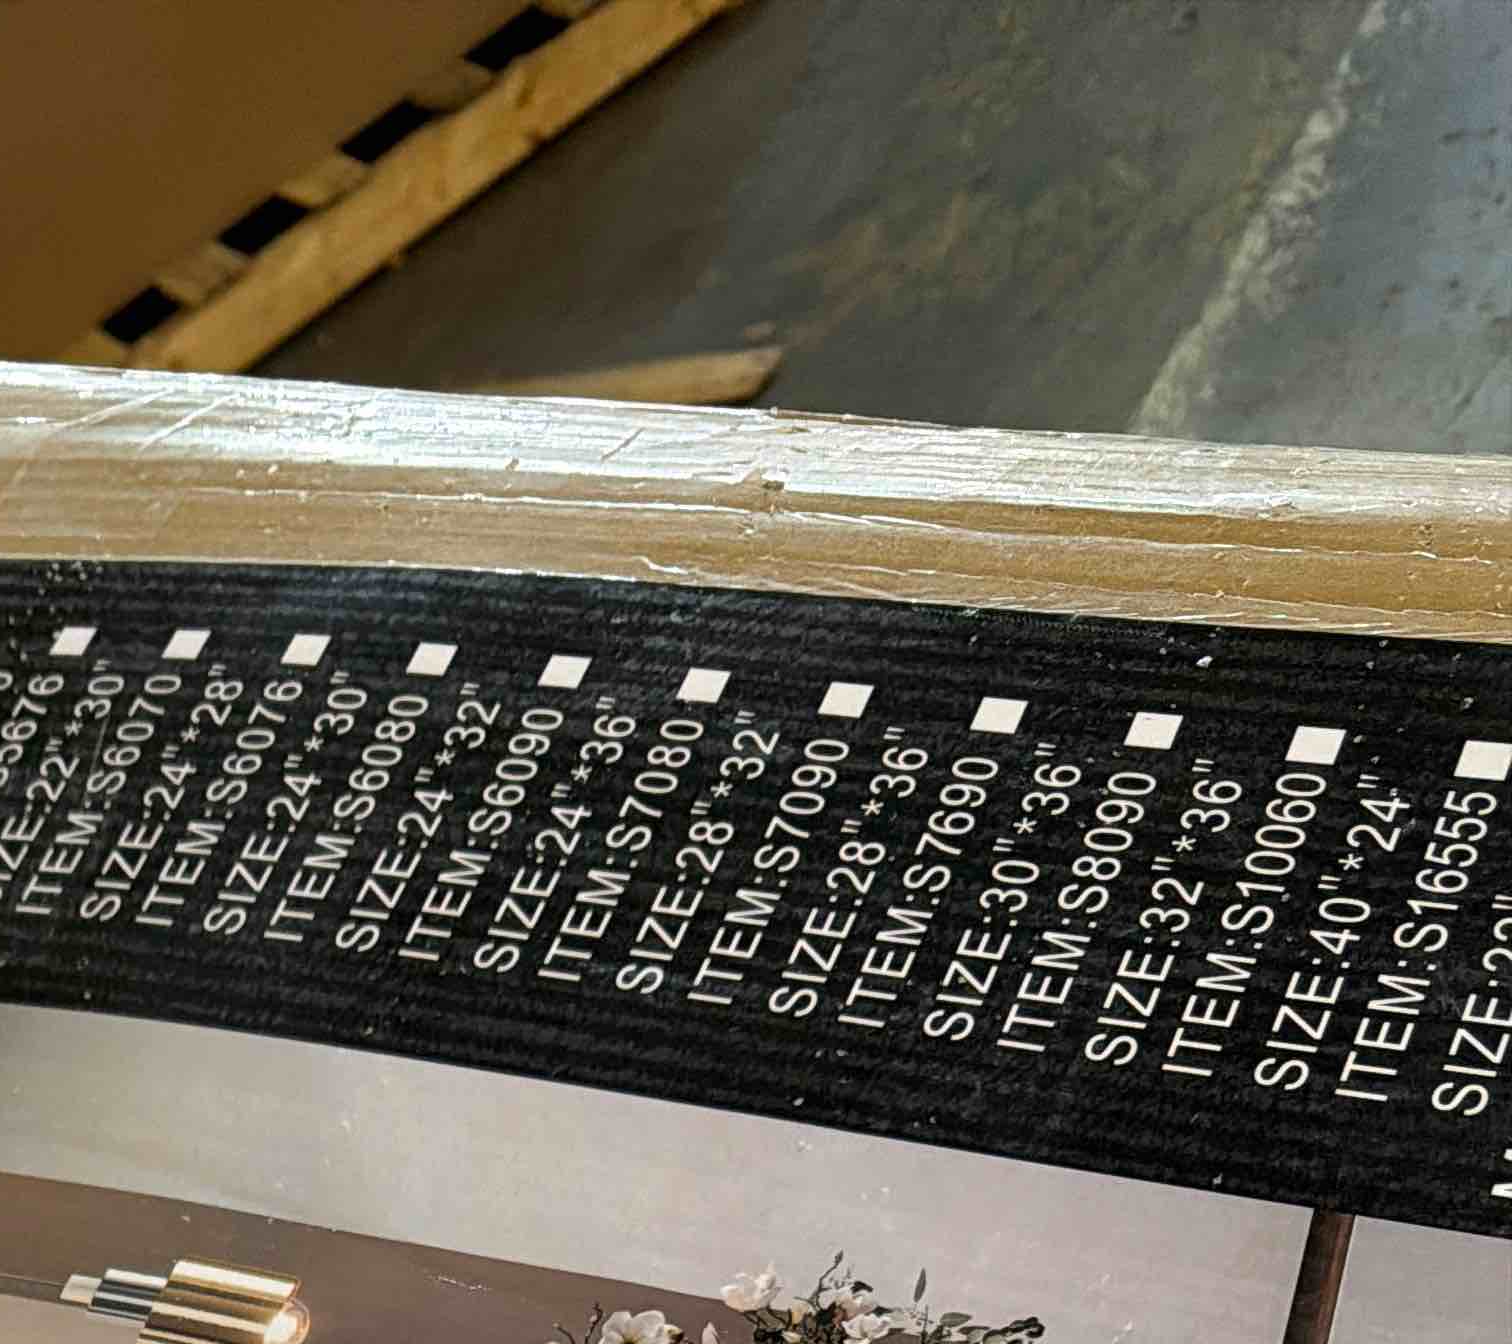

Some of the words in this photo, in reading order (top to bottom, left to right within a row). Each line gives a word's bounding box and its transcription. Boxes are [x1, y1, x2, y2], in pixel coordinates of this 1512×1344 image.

[16, 675, 182, 914] ITEM:S6070
[135, 680, 303, 926] ITEM:S6076
[264, 696, 429, 943] ITEM:S6080
[398, 708, 563, 960] ITEM:S6090
[538, 719, 704, 982] ITEM:S7080
[688, 739, 849, 1005] ITEM:S7090
[837, 757, 999, 1030] ITEM:S7690
[996, 772, 1156, 1052] ITEM:S8090
[1161, 773, 1328, 1077] ITEM:S10060
[1335, 792, 1497, 1101] ITEM:S16555
